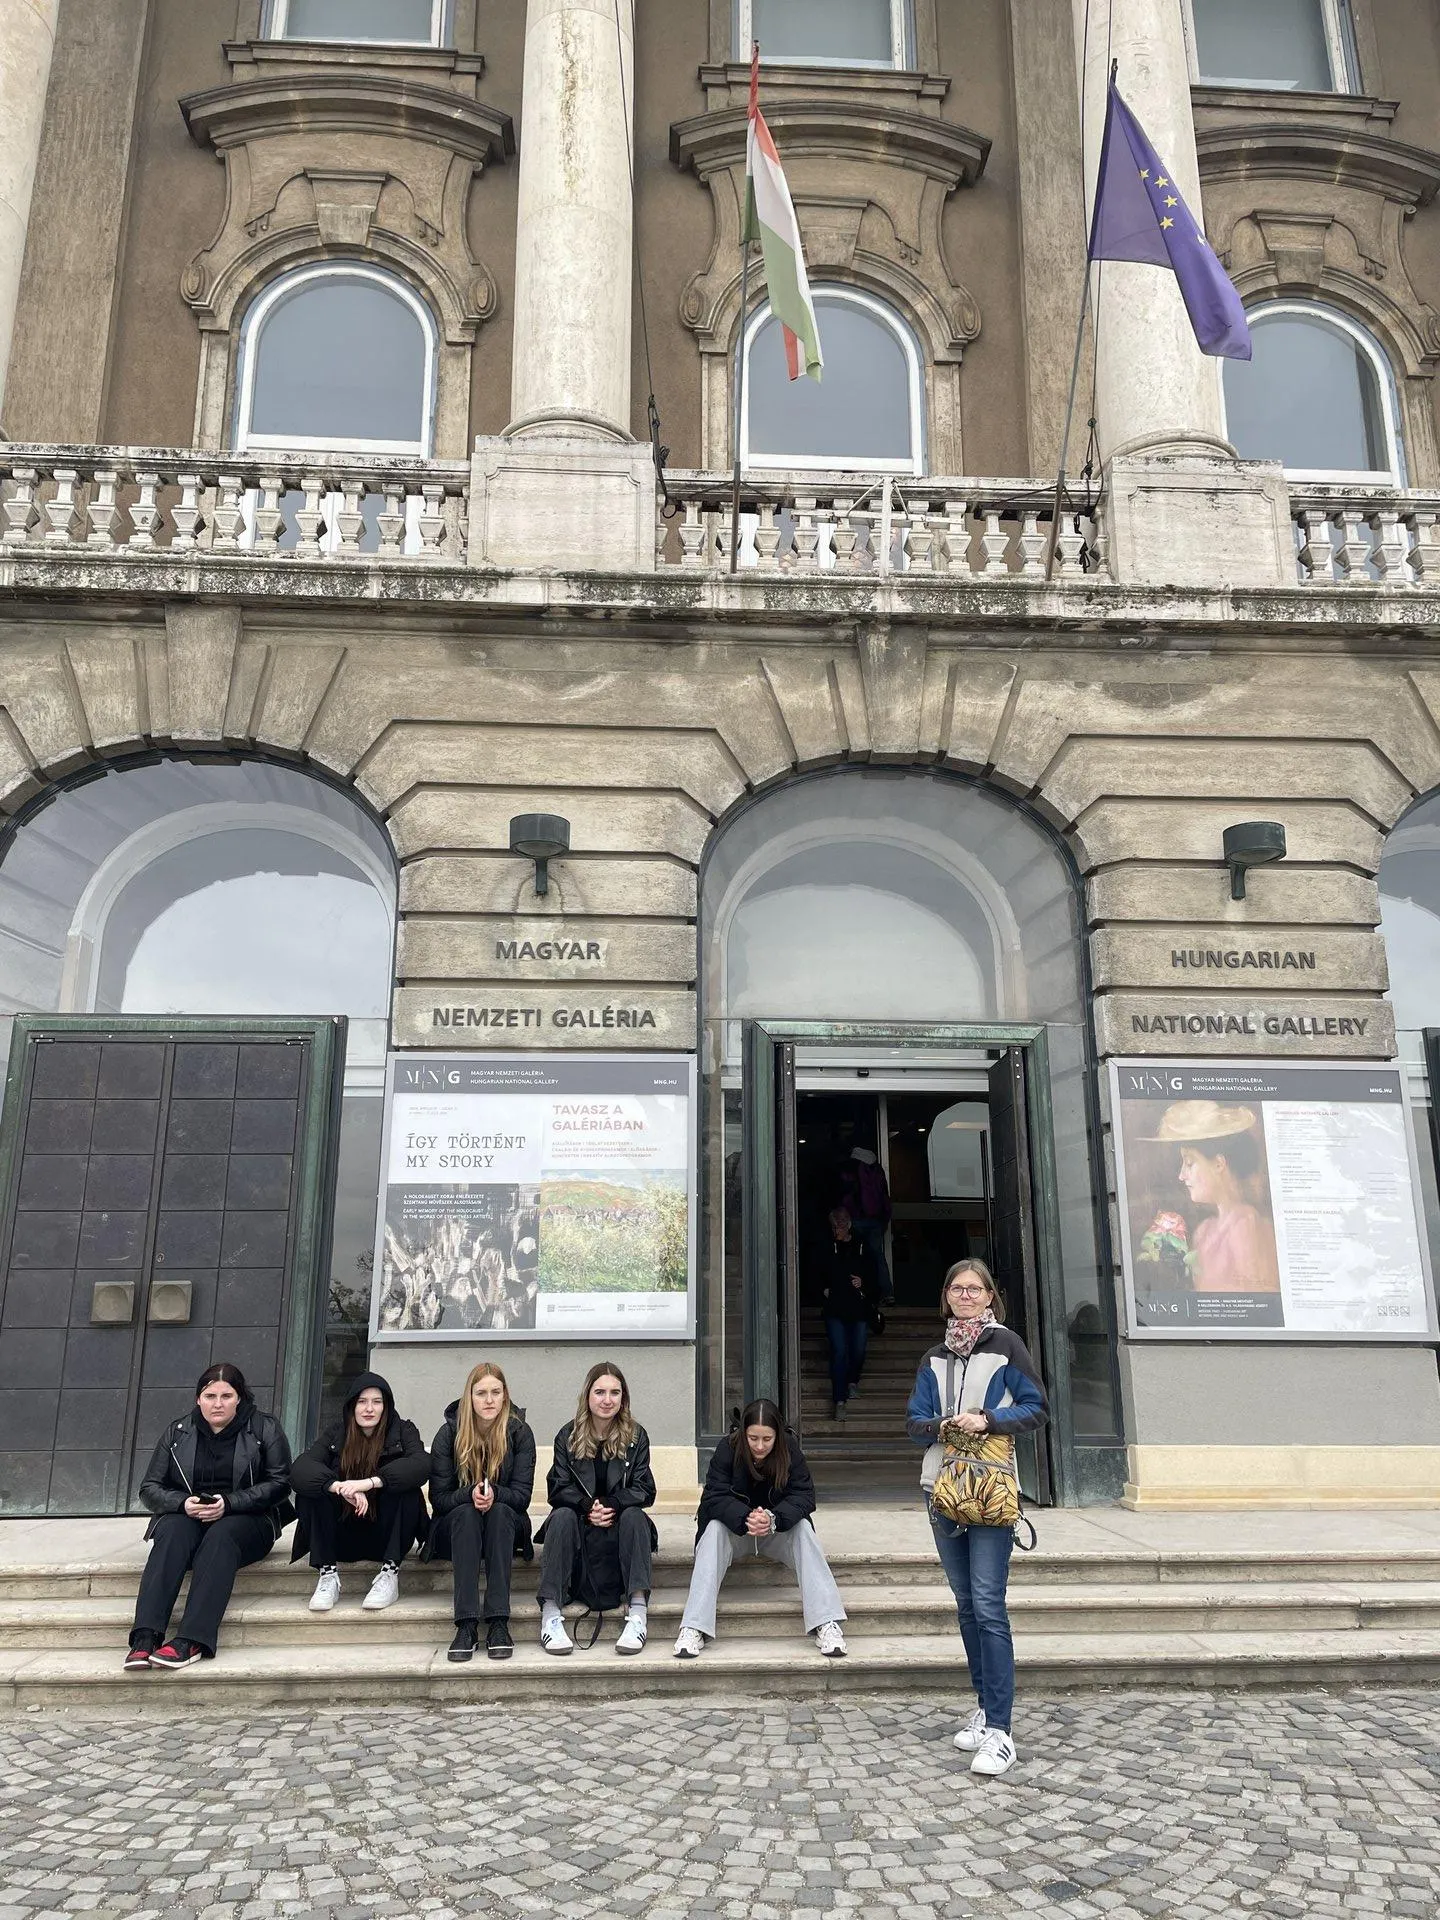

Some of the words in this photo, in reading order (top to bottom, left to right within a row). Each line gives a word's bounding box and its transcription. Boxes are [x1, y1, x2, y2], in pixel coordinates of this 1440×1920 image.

[495, 941, 601, 960] MAGYAR
[1171, 950, 1316, 969] HUNGARIAN
[433, 1008, 542, 1027] NEMZETI
[552, 1006, 657, 1028] GALÉRIA
[1131, 1015, 1257, 1035] NATIONAL
[1264, 1017, 1369, 1036] GALLERY
[552, 1104, 609, 1115] TAVASZ
[612, 1104, 624, 1115] A
[552, 1117, 644, 1131] GALÉRIÁBAN
[405, 1132, 438, 1149] ÍGY
[447, 1132, 526, 1149] TÖRTÉNT
[406, 1155, 429, 1168] MY
[438, 1155, 495, 1168] STORY
